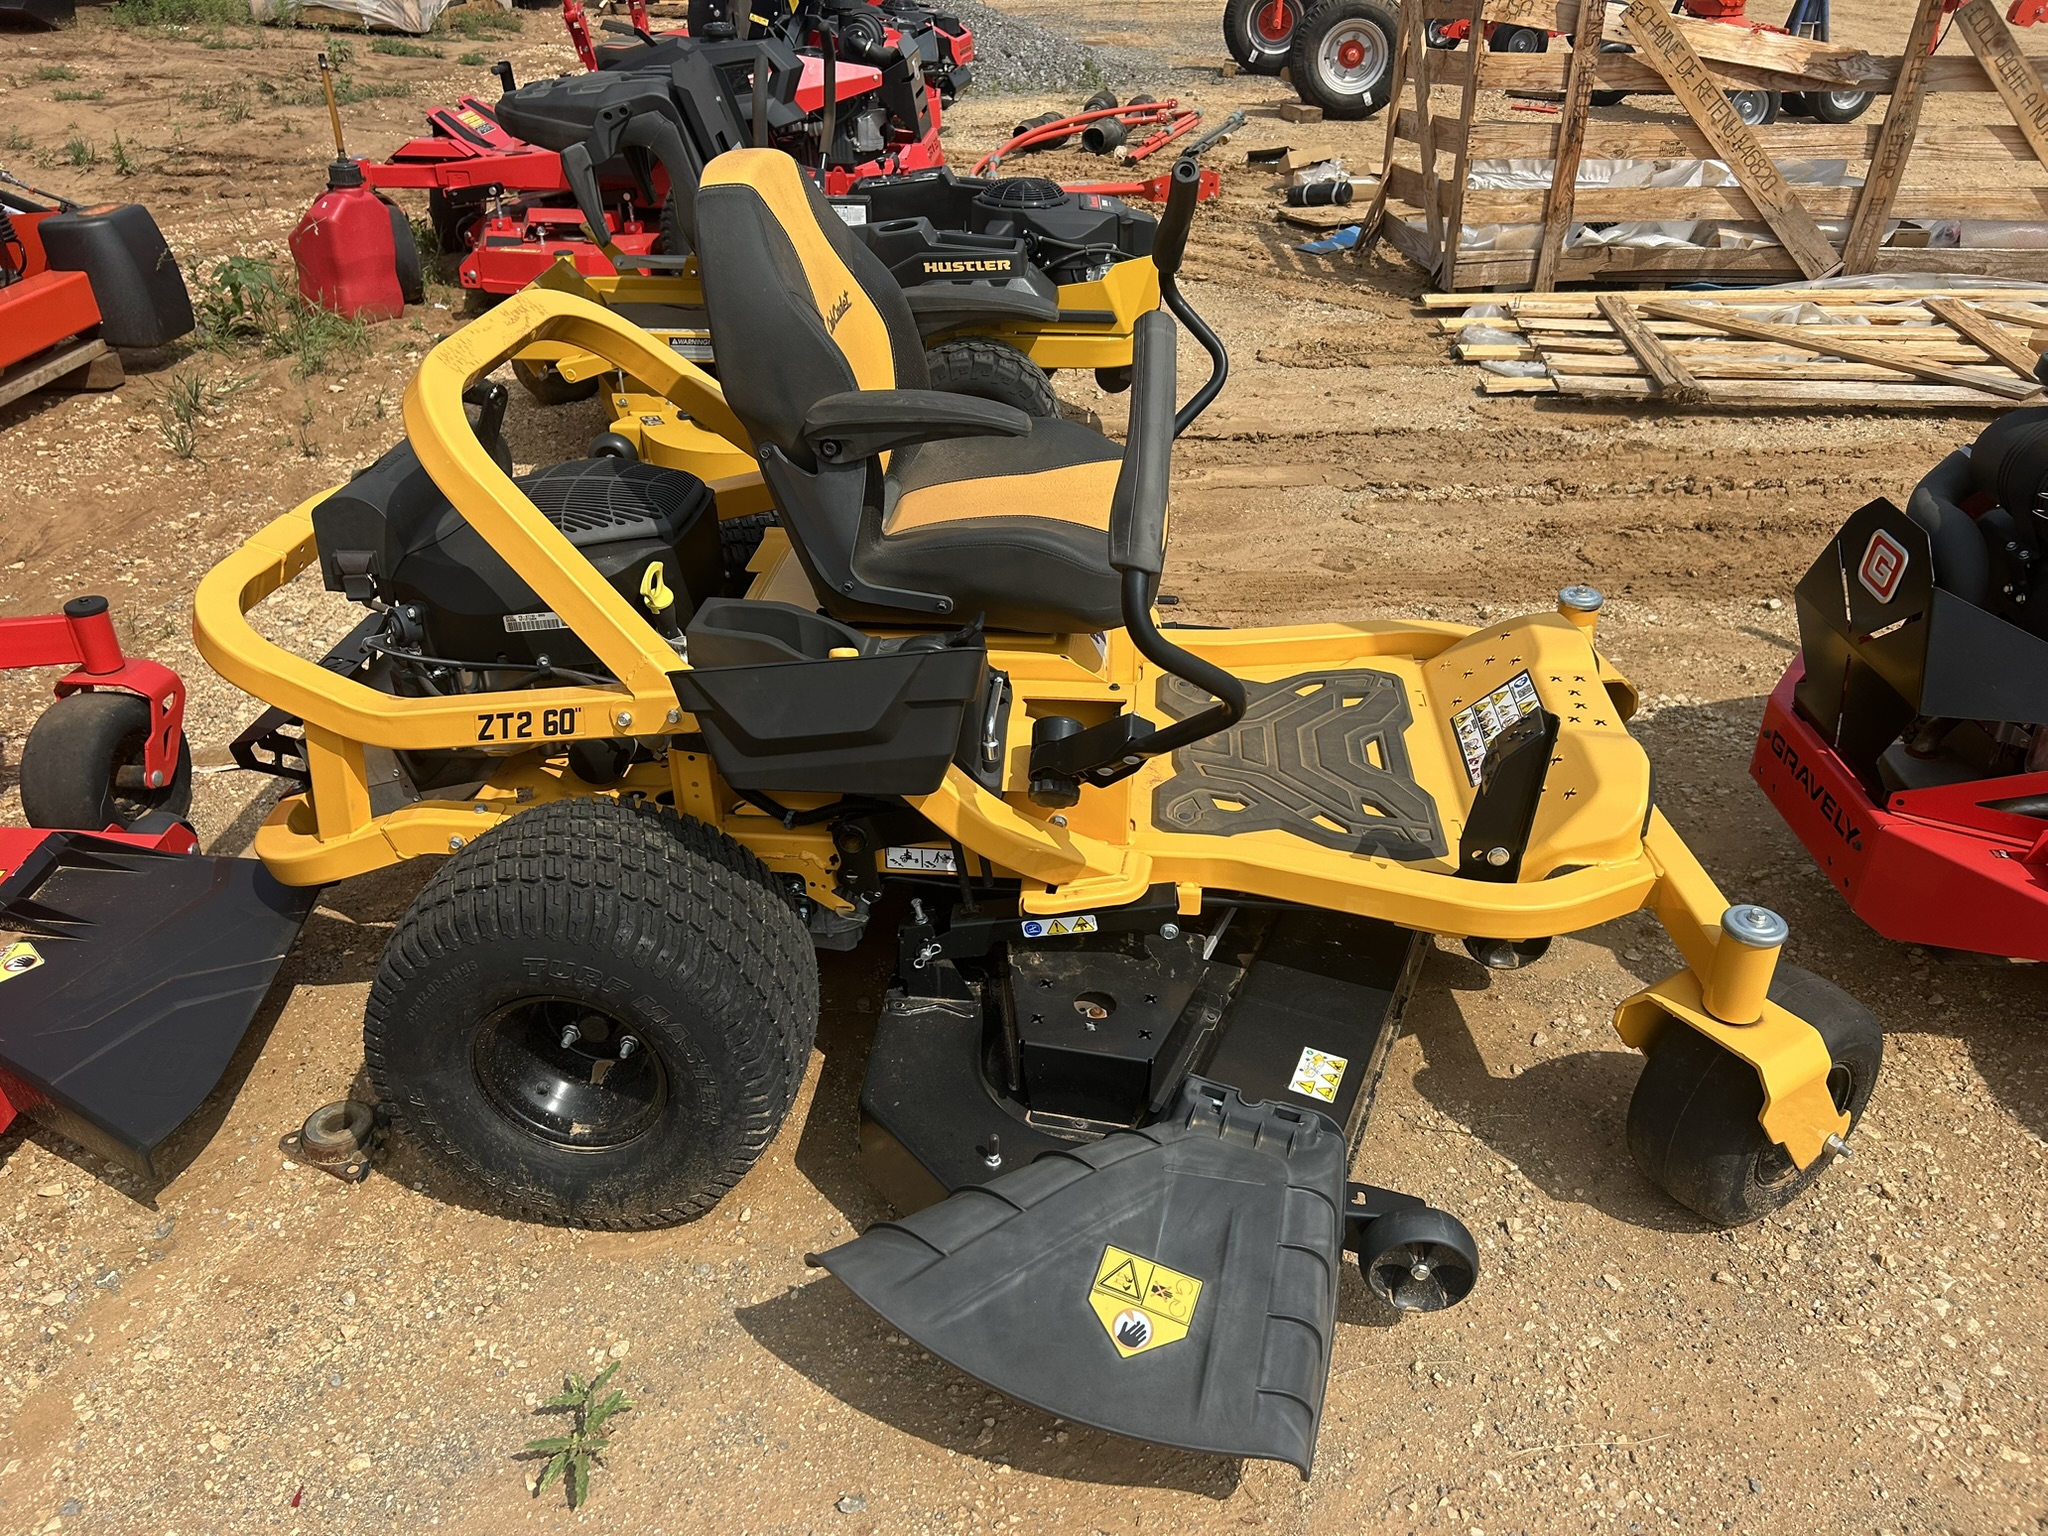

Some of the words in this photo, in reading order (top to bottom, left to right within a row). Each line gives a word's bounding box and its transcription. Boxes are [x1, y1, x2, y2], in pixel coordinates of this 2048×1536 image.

[923, 260, 1011, 273] HUSTLER
[477, 711, 532, 741] ZT2
[543, 707, 582, 736] 60"
[1770, 729, 1862, 846] GRAVELY
[522, 956, 632, 993] TURF
[631, 995, 721, 1125] MASTER
